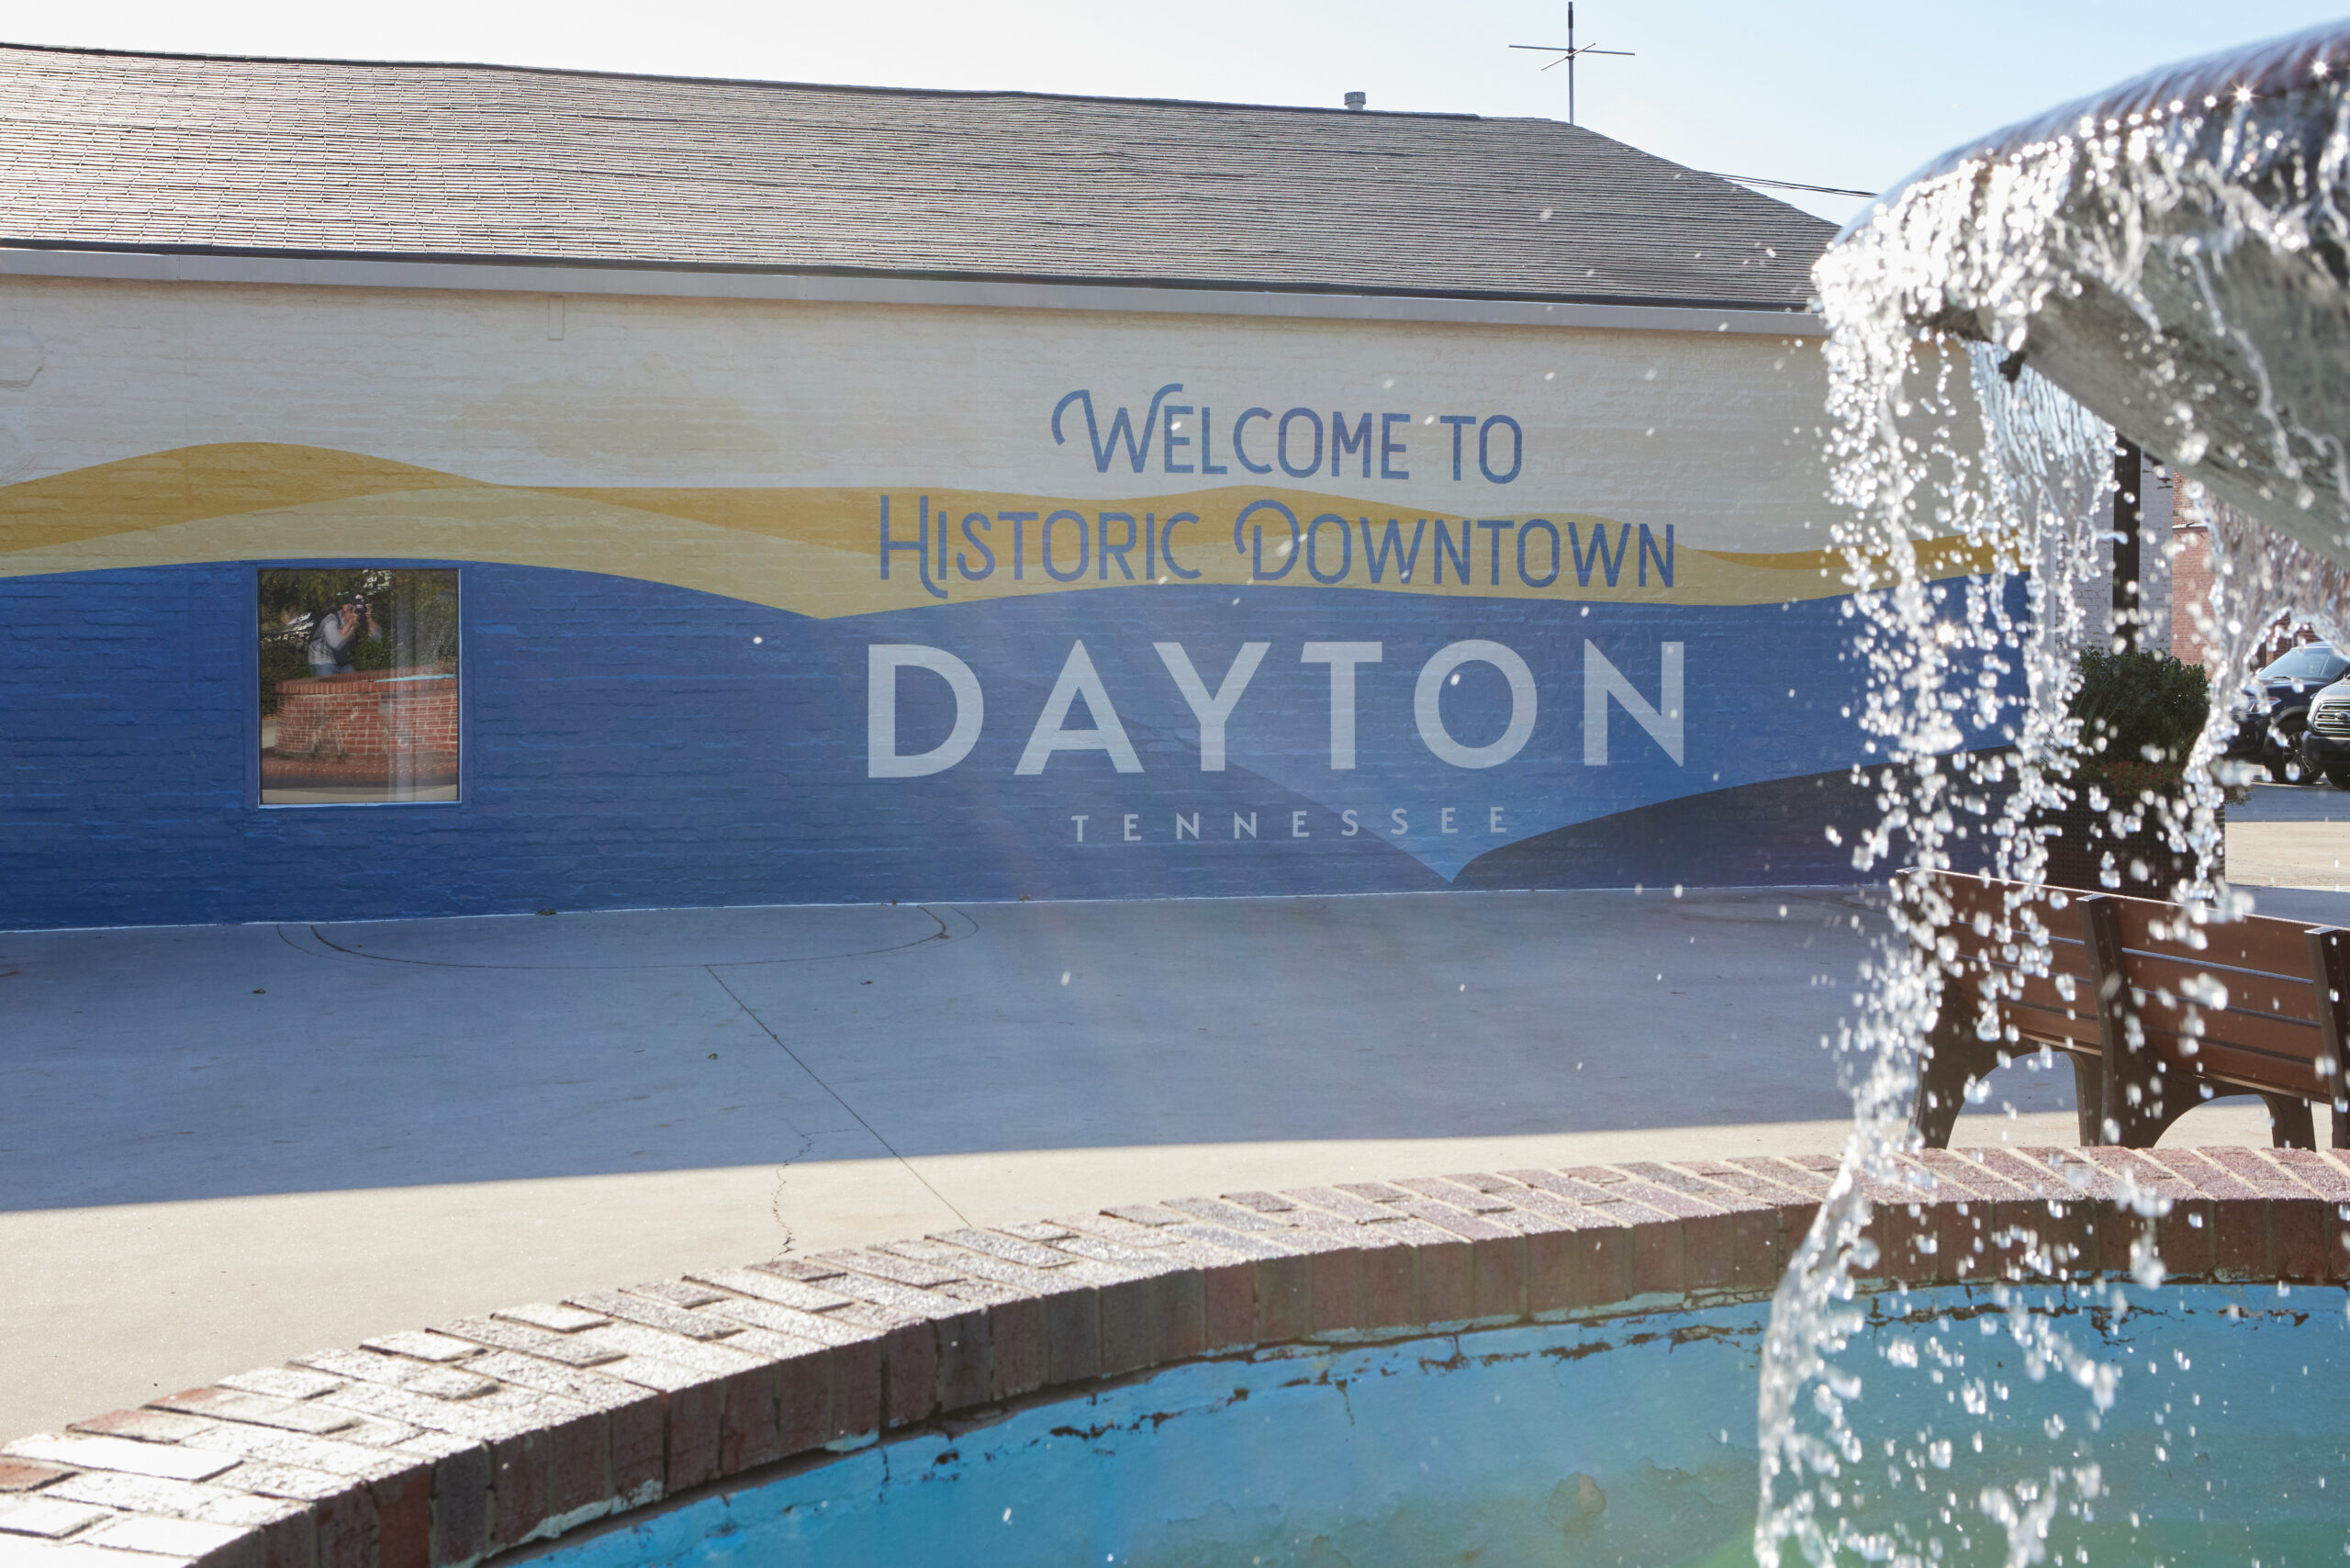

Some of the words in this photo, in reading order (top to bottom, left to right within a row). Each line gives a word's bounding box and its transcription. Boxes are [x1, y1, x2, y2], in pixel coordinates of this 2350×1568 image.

[1051, 383, 1411, 481] WELCOME
[1439, 414, 1523, 485] TO
[880, 495, 1202, 599] HISTORIC
[1234, 499, 1674, 588] DOWNTOWN
[867, 640, 1685, 778] DAYTON
[1071, 806, 1507, 843] TENNESSEE
